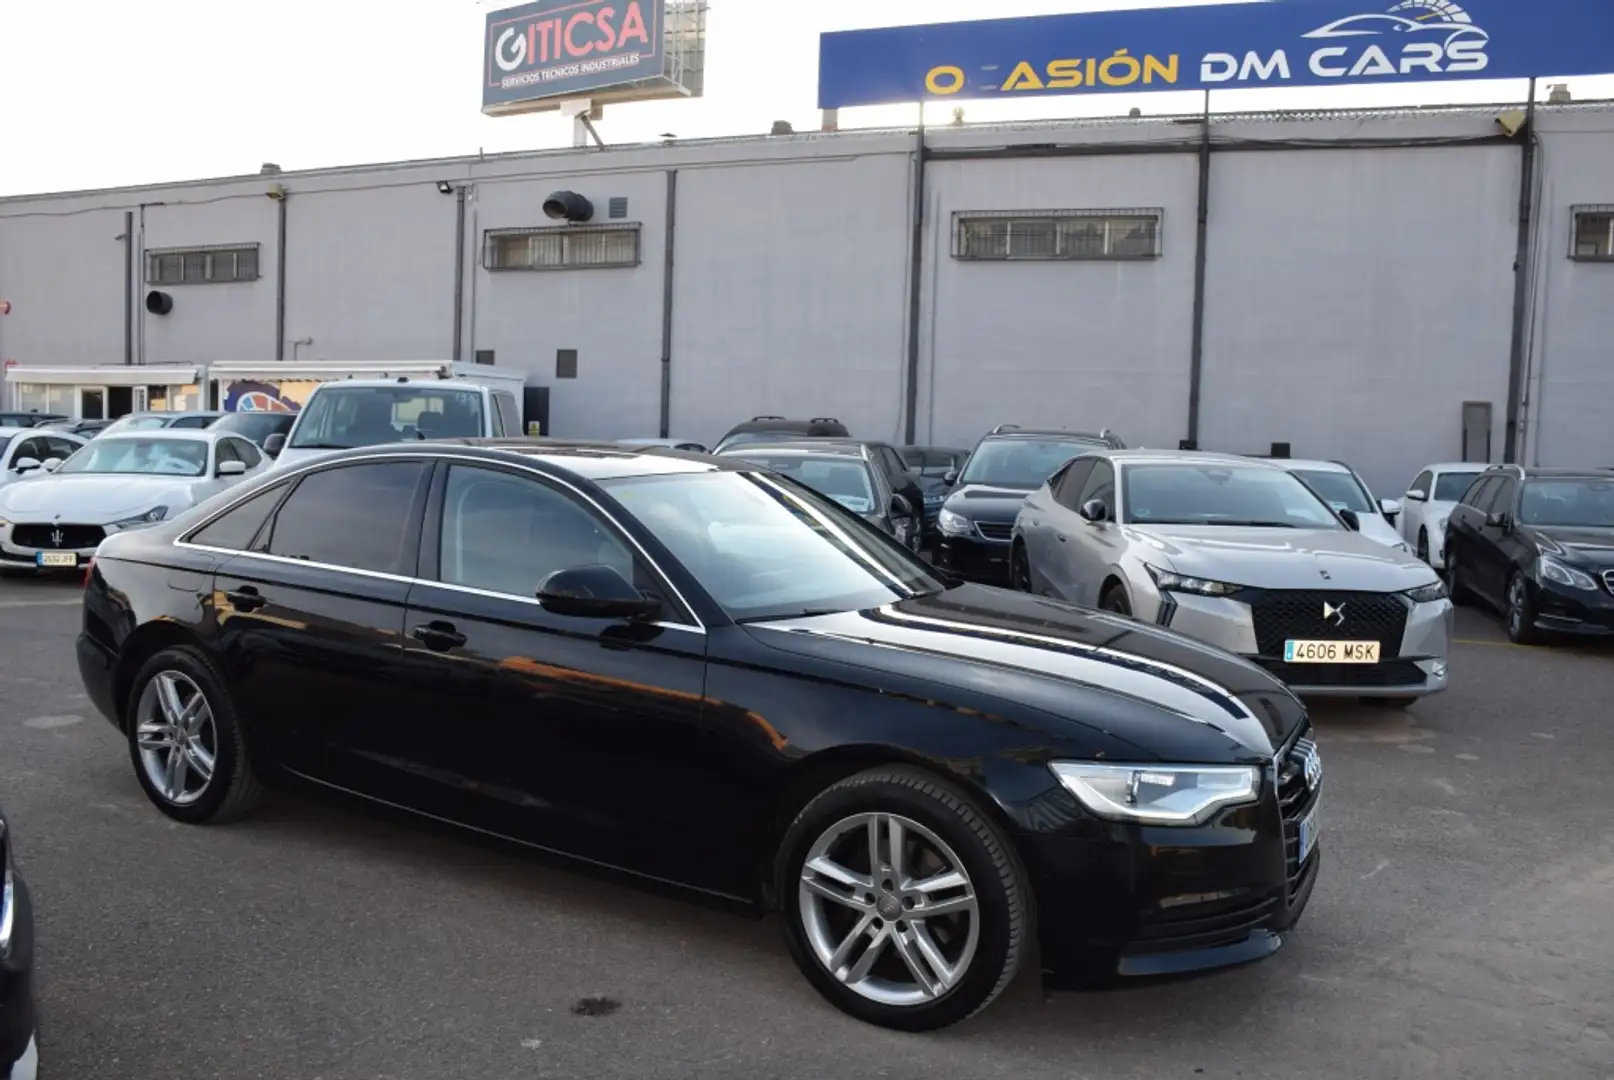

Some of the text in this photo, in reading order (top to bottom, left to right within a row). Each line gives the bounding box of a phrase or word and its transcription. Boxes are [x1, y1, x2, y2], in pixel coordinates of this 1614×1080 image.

[495, 1, 648, 71] GITICSA
[501, 72, 540, 88] SERVICIOS
[580, 53, 640, 73] INDUSTRIALES
[1200, 49, 1291, 82] DM
[1309, 40, 1489, 77] CARS
[1296, 643, 1375, 660] 4606 MSK
